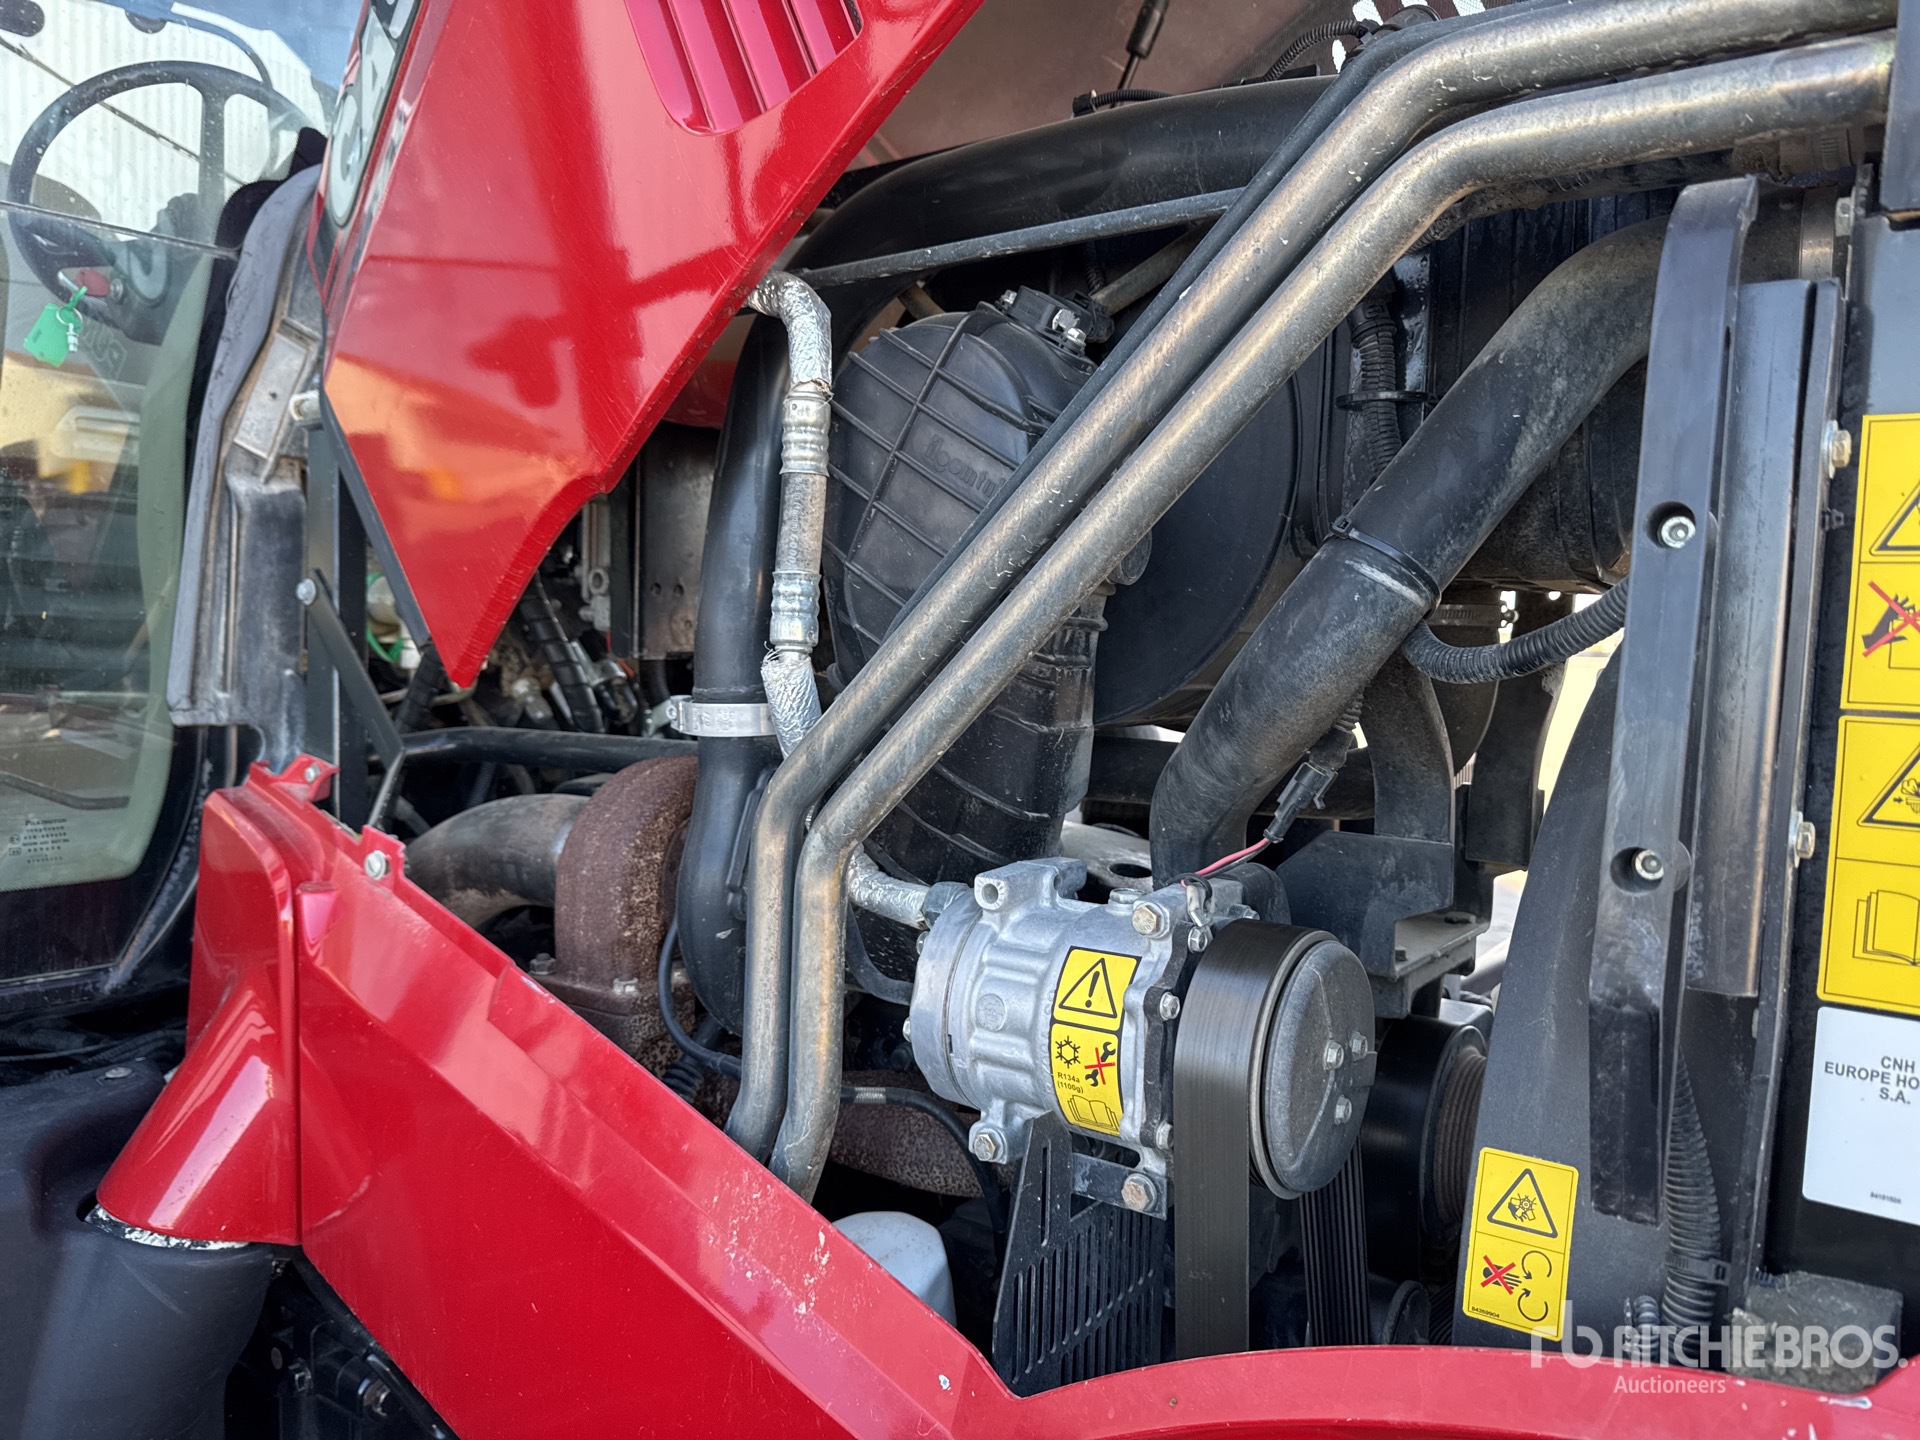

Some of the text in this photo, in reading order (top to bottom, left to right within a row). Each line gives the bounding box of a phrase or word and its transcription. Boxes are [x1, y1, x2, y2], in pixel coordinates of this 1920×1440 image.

[1824, 1061, 1891, 1085] EUROPE
[1881, 1055, 1915, 1074] CNH
[1057, 1072, 1080, 1083] R134a
[1057, 1081, 1084, 1094] (1100g)
[1879, 1086, 1911, 1105] S.A.
